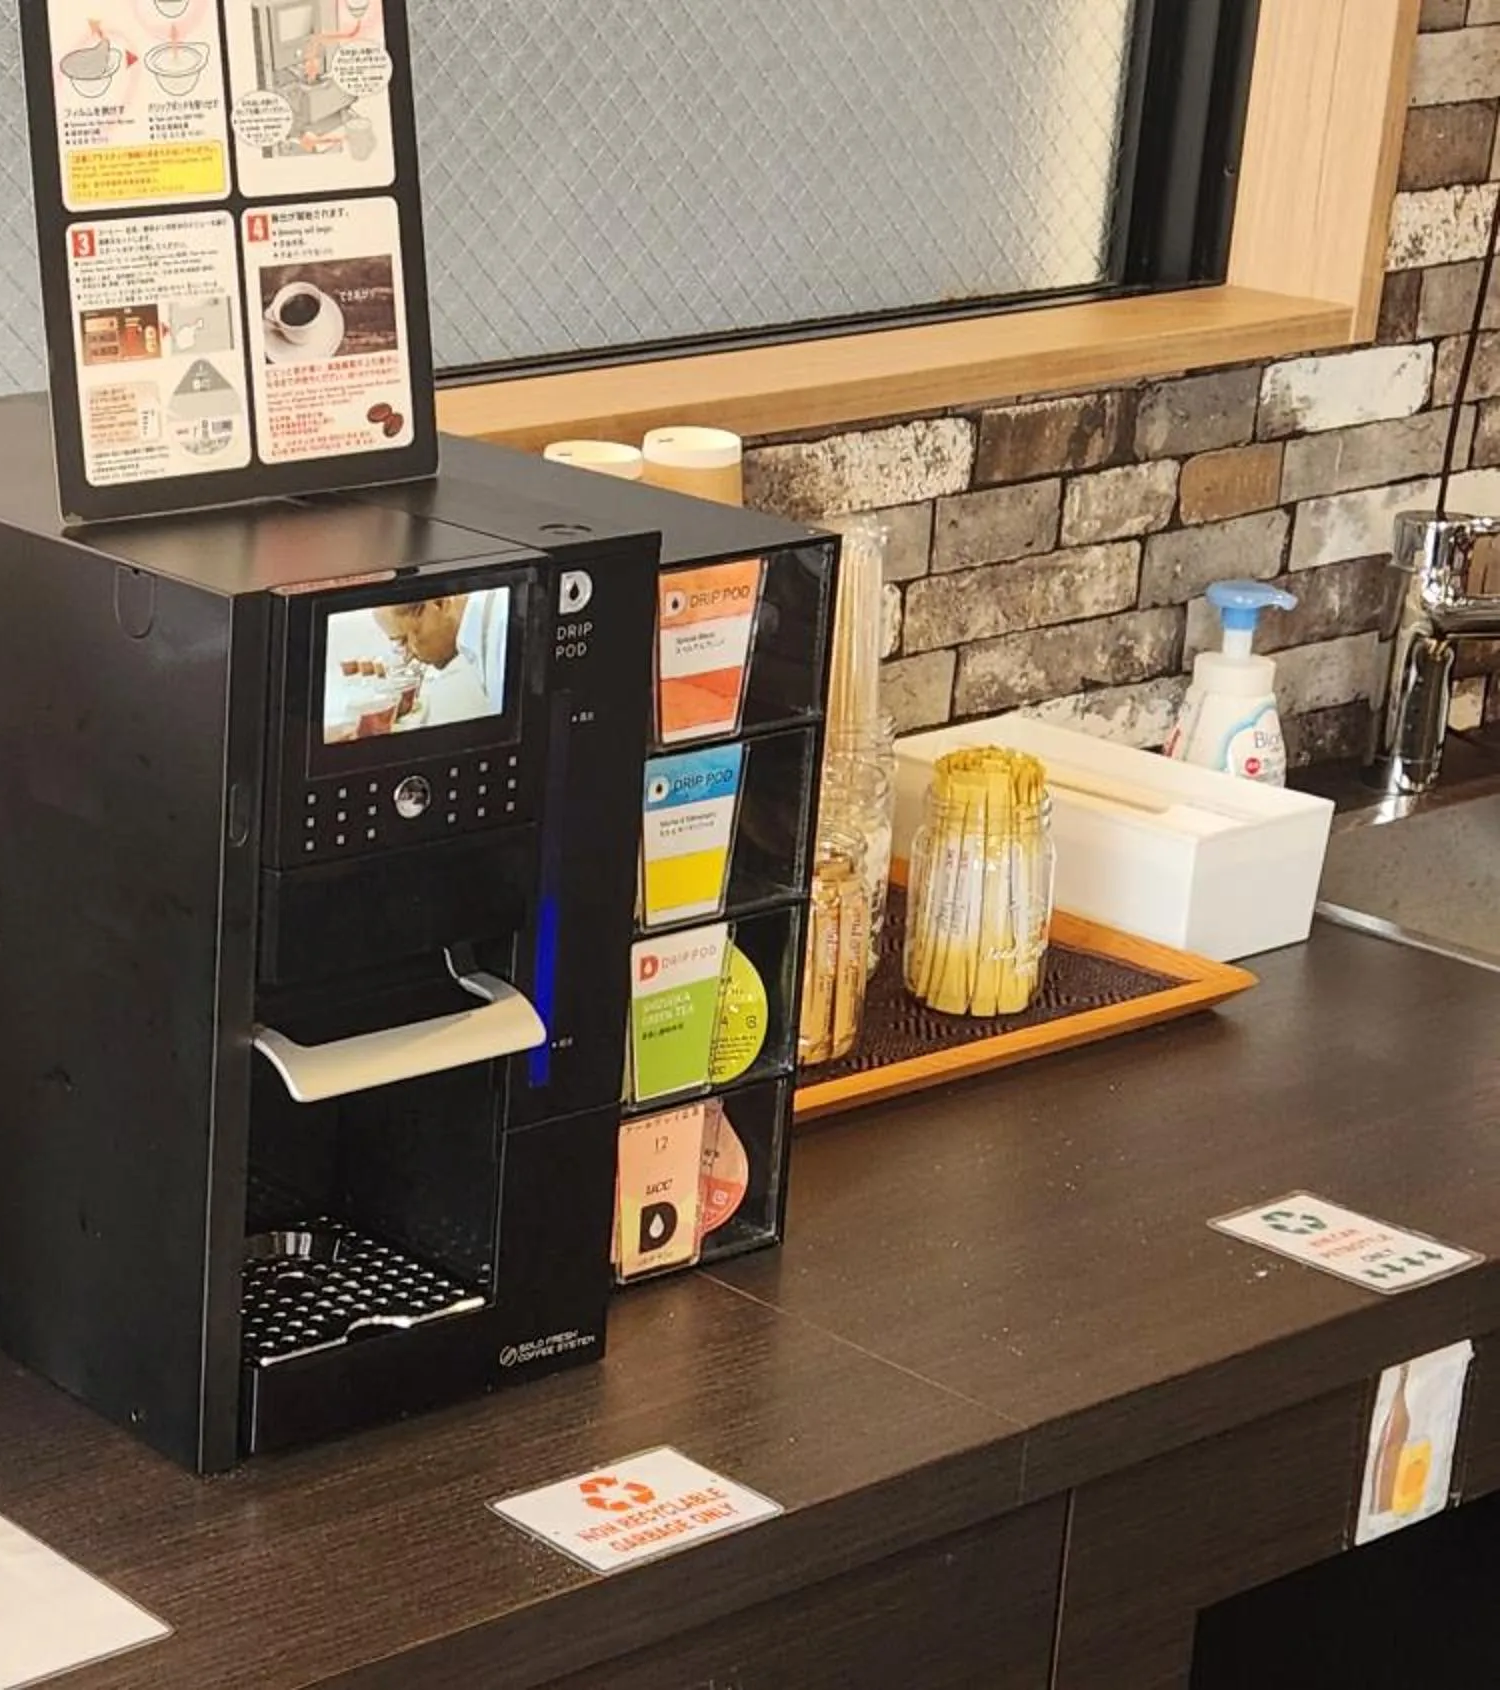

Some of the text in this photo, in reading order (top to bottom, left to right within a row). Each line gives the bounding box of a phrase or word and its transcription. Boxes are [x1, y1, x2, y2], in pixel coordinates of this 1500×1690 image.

[689, 590, 720, 609] DRIP
[723, 585, 751, 601] POD
[557, 621, 593, 641] DRIP
[555, 641, 588, 661] POD
[673, 775, 704, 793] DRIP
[706, 768, 733, 786] POD
[654, 1135, 670, 1151] 12
[577, 1486, 730, 1543] NON RECYCLABLE
[608, 1501, 741, 1553] GARBAGE ONLY
